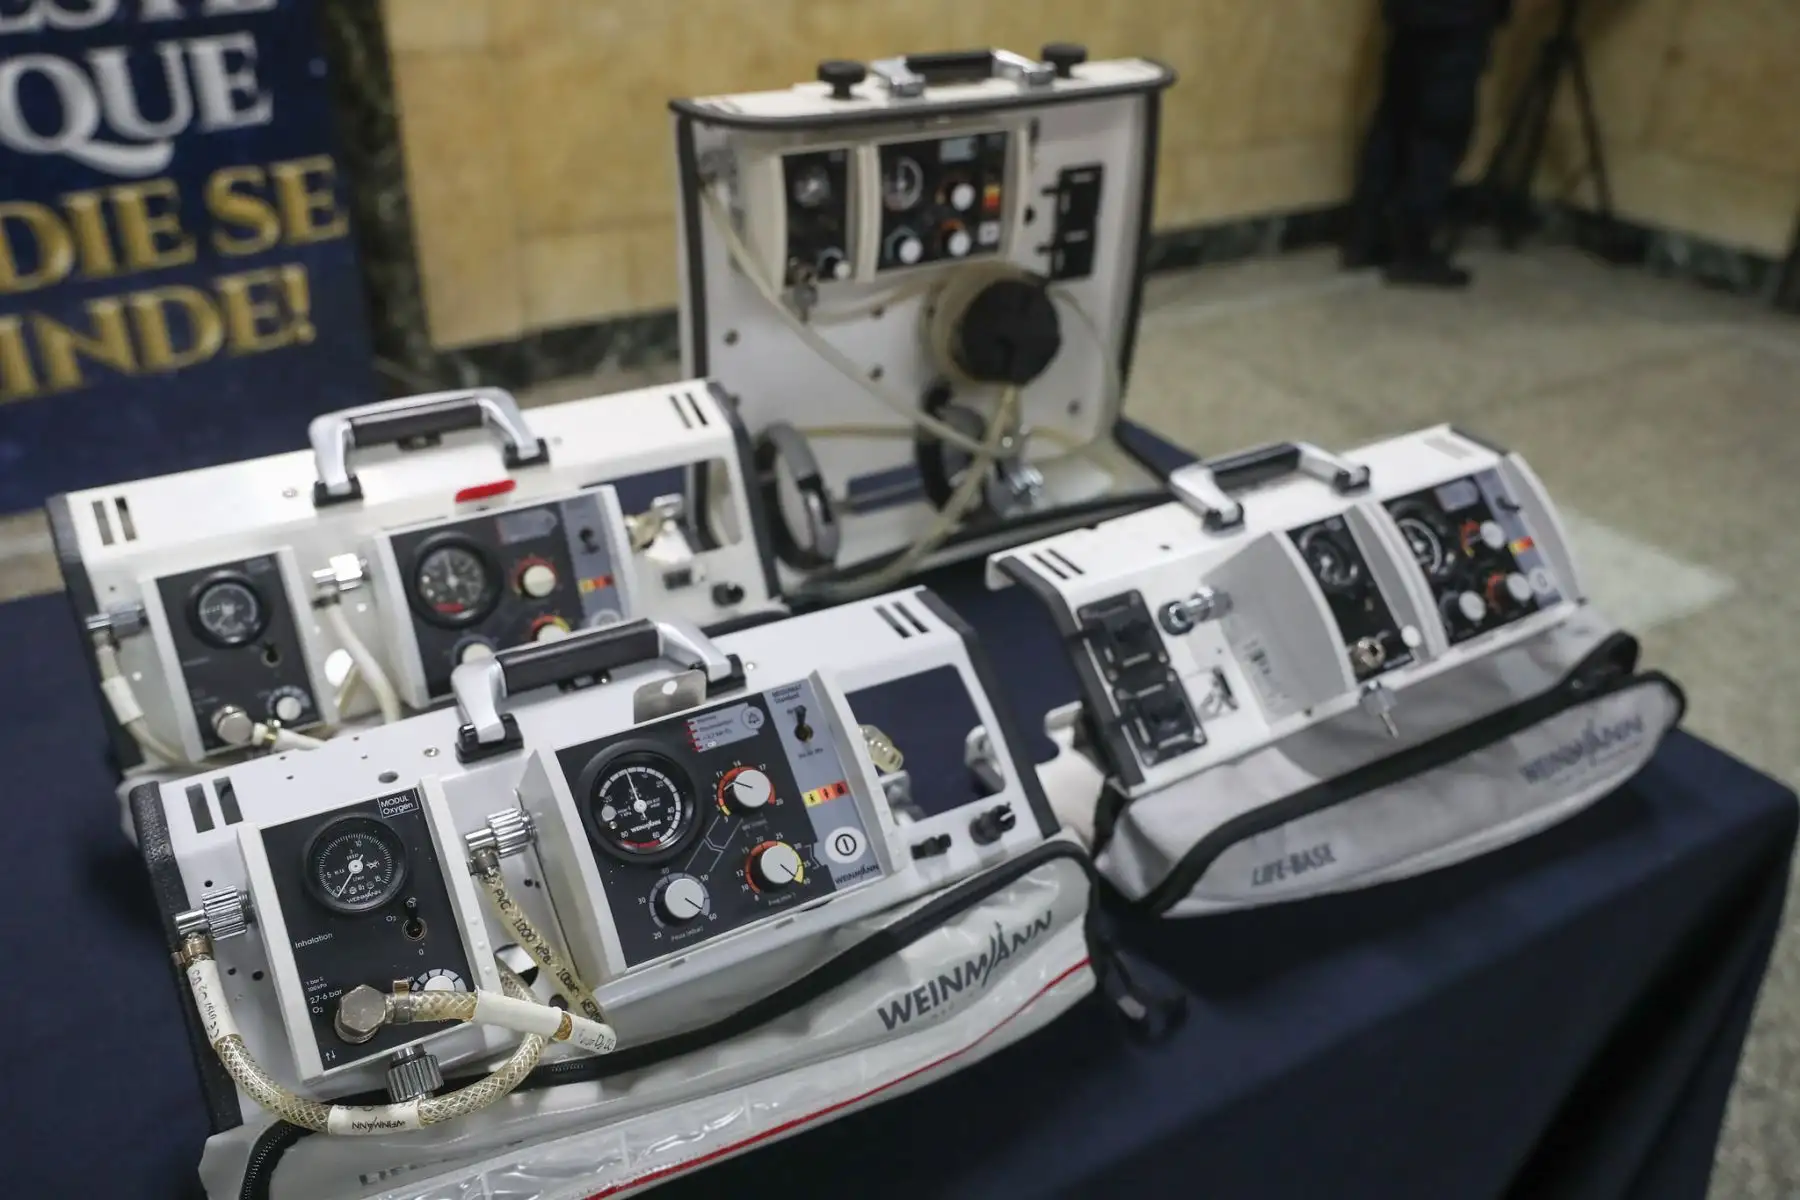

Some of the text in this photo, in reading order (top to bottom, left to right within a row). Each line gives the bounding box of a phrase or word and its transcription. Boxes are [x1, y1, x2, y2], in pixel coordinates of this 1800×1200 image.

[0, 31, 274, 177] QUE
[206, 152, 349, 257] SE
[380, 795, 409, 808] MODUL
[382, 802, 414, 815] Oxygen
[295, 932, 333, 949] Inhalation
[877, 910, 1053, 1031] WEINMANN
[329, 989, 342, 998] bar
